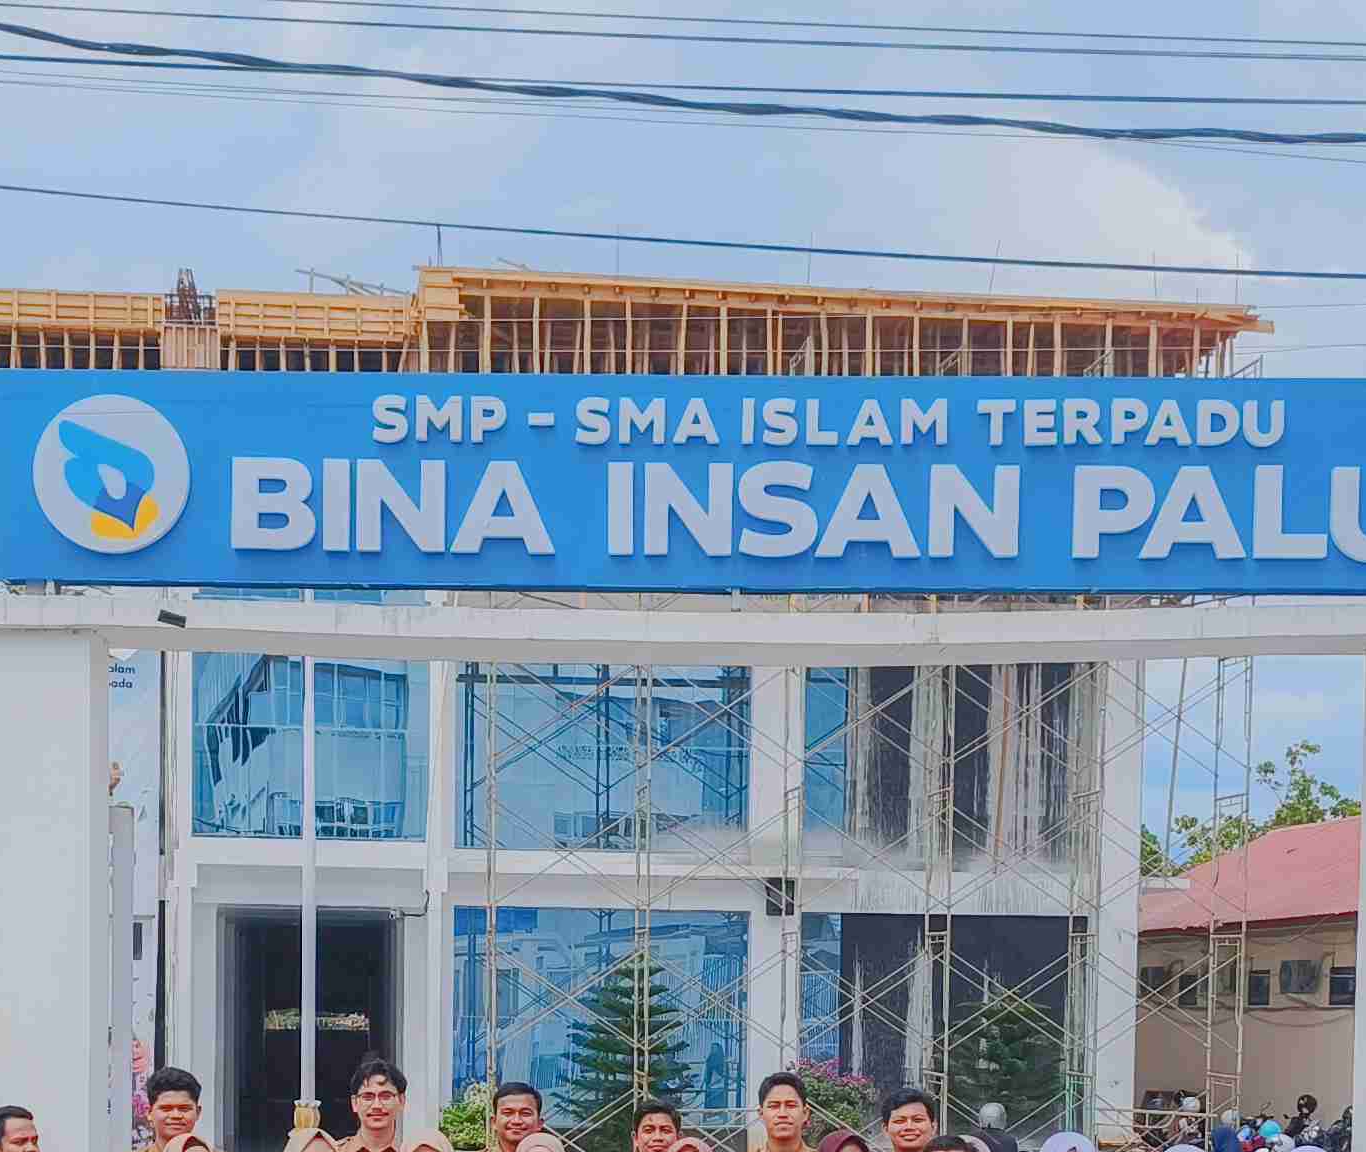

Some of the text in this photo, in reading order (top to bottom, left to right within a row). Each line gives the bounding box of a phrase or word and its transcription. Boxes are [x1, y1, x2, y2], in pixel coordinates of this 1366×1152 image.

[372, 394, 507, 443] SMP
[575, 397, 718, 445] SMA
[741, 398, 948, 446] ISLAM
[977, 398, 1285, 447] TERPADU
[231, 457, 554, 554] BINA
[608, 461, 1020, 558] INSAN
